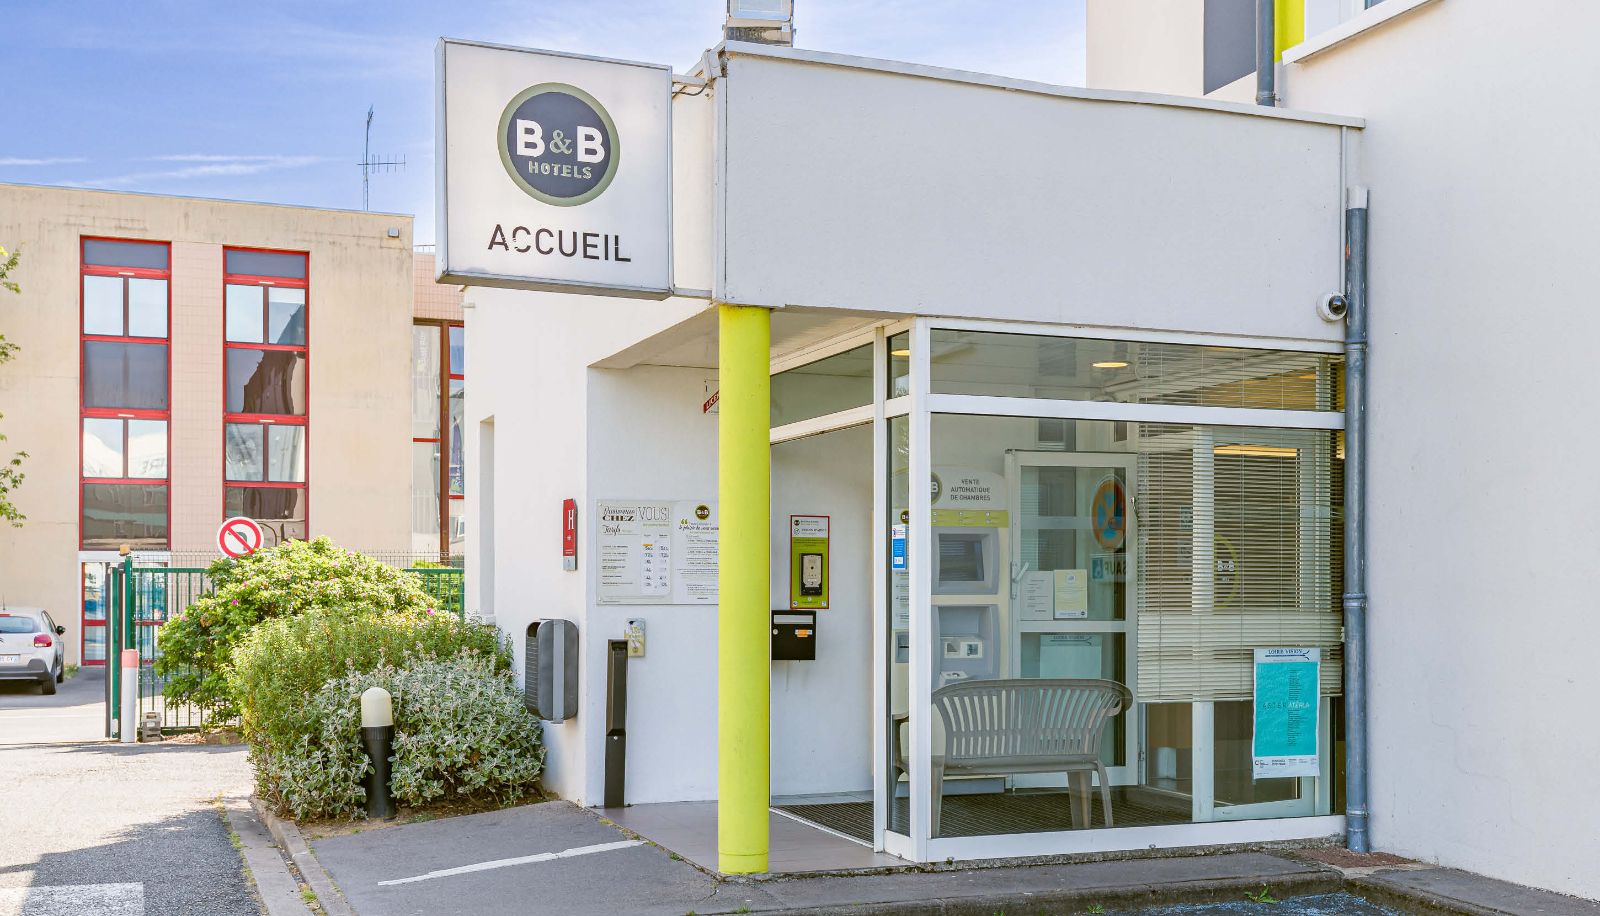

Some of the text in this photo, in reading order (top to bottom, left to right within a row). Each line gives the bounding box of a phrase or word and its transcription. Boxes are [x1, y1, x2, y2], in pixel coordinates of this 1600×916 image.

[516, 118, 606, 164] B&B
[528, 160, 592, 180] HOTELS
[487, 223, 632, 263] ACCUEIL
[950, 486, 991, 494] AUTOMATIQUE
